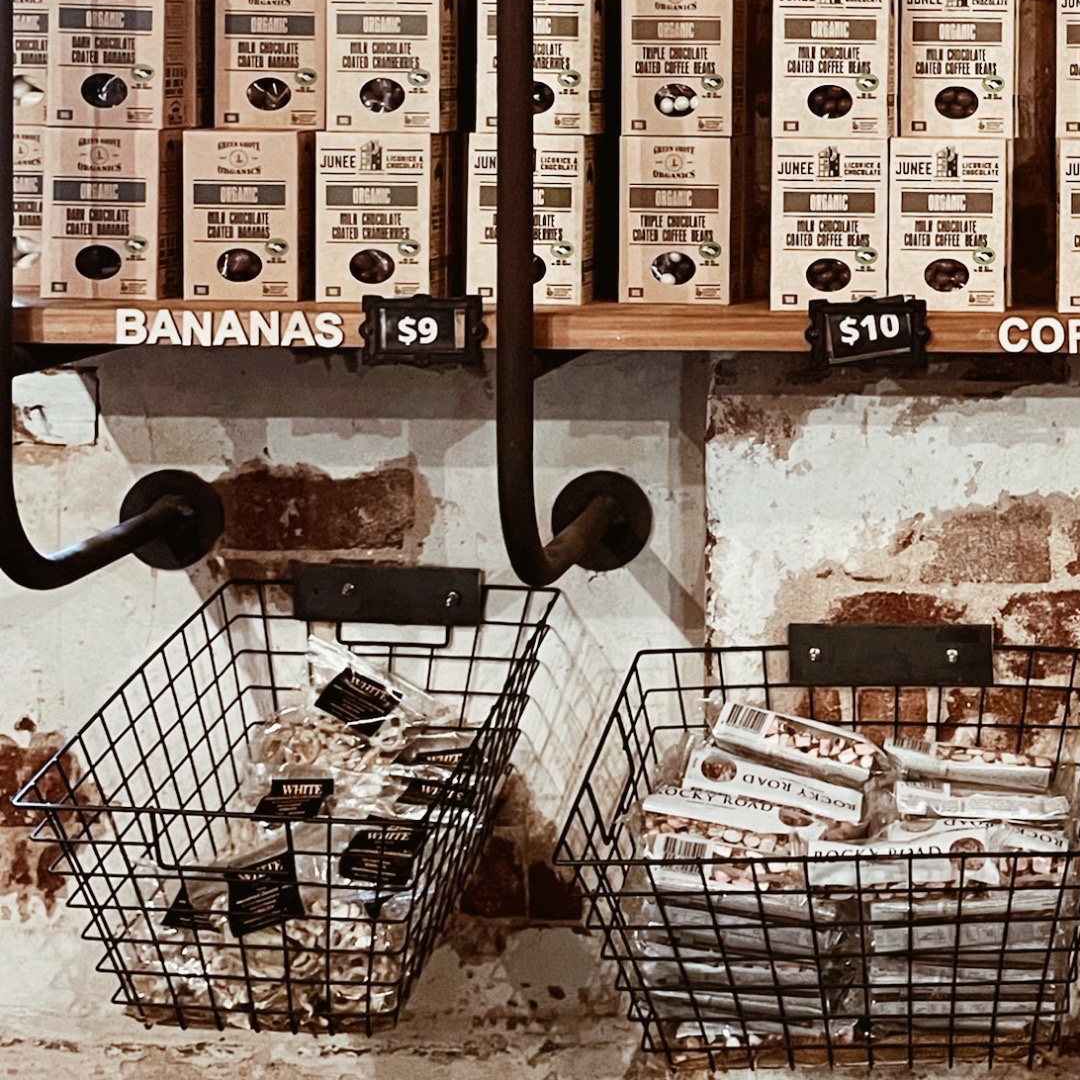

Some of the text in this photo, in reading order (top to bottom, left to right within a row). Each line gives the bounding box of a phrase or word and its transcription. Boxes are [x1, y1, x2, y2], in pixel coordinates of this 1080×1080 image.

[350, 43, 411, 54] MILK CHOCOLATE
[643, 47, 707, 60] TRIPLE CHOCOLATE
[926, 49, 985, 61] MILK CHOCOLATE
[343, 57, 368, 68] COATED
[635, 61, 715, 74] COATED COFFEE BEANS
[916, 62, 996, 75] COATED COFFEE BEANS
[320, 156, 356, 169] JUNEE
[778, 162, 814, 175] JUNEE
[896, 162, 931, 175] JUNEE
[208, 212, 269, 224] MILK CHOCOLATE
[208, 226, 233, 238] COATED
[116, 308, 344, 348] BANANAS
[398, 315, 438, 346] $9
[839, 314, 899, 346] $10
[282, 784, 323, 796] WHITE
[742, 773, 856, 812] ROCKY ROAD
[723, 794, 773, 812] ROAD
